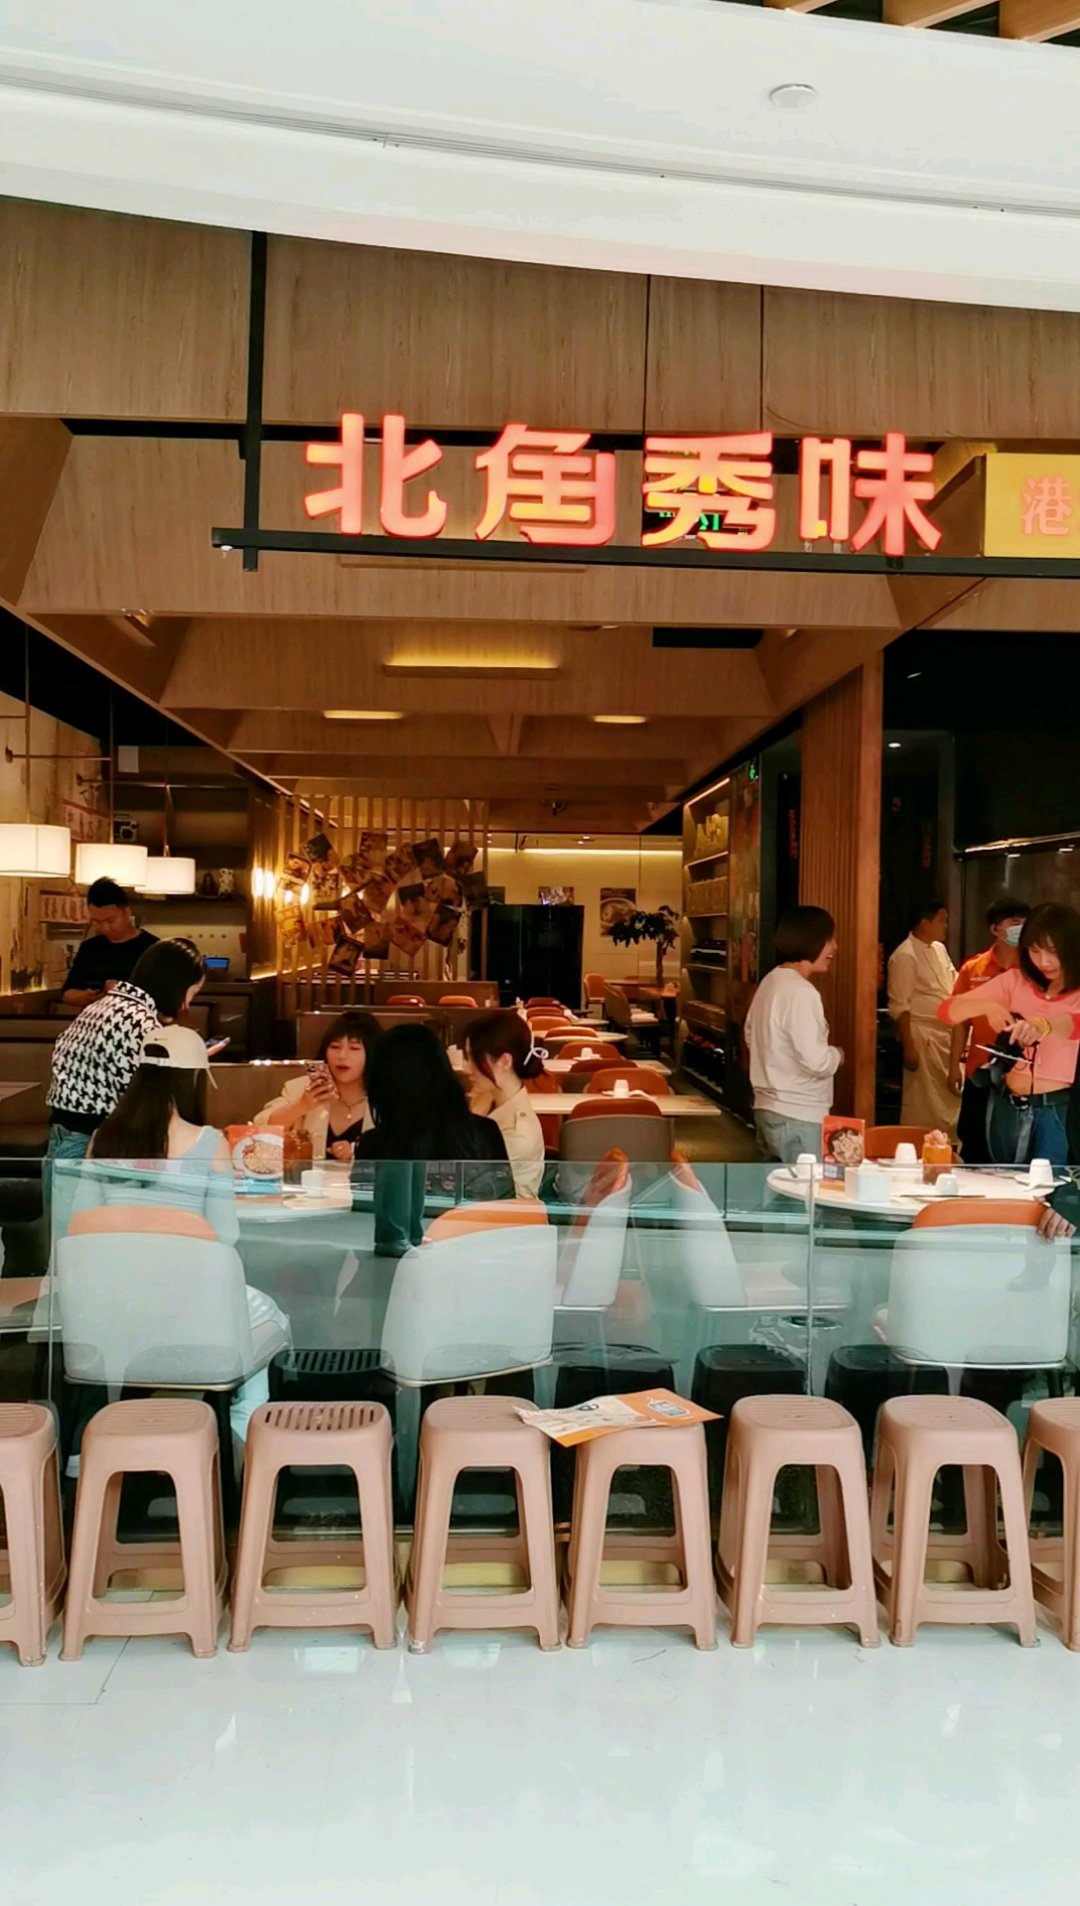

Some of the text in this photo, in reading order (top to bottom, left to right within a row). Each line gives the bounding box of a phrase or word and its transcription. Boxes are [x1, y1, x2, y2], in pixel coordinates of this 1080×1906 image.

[303, 412, 942, 557] 北角秀味
[1020, 475, 1073, 536] 港
